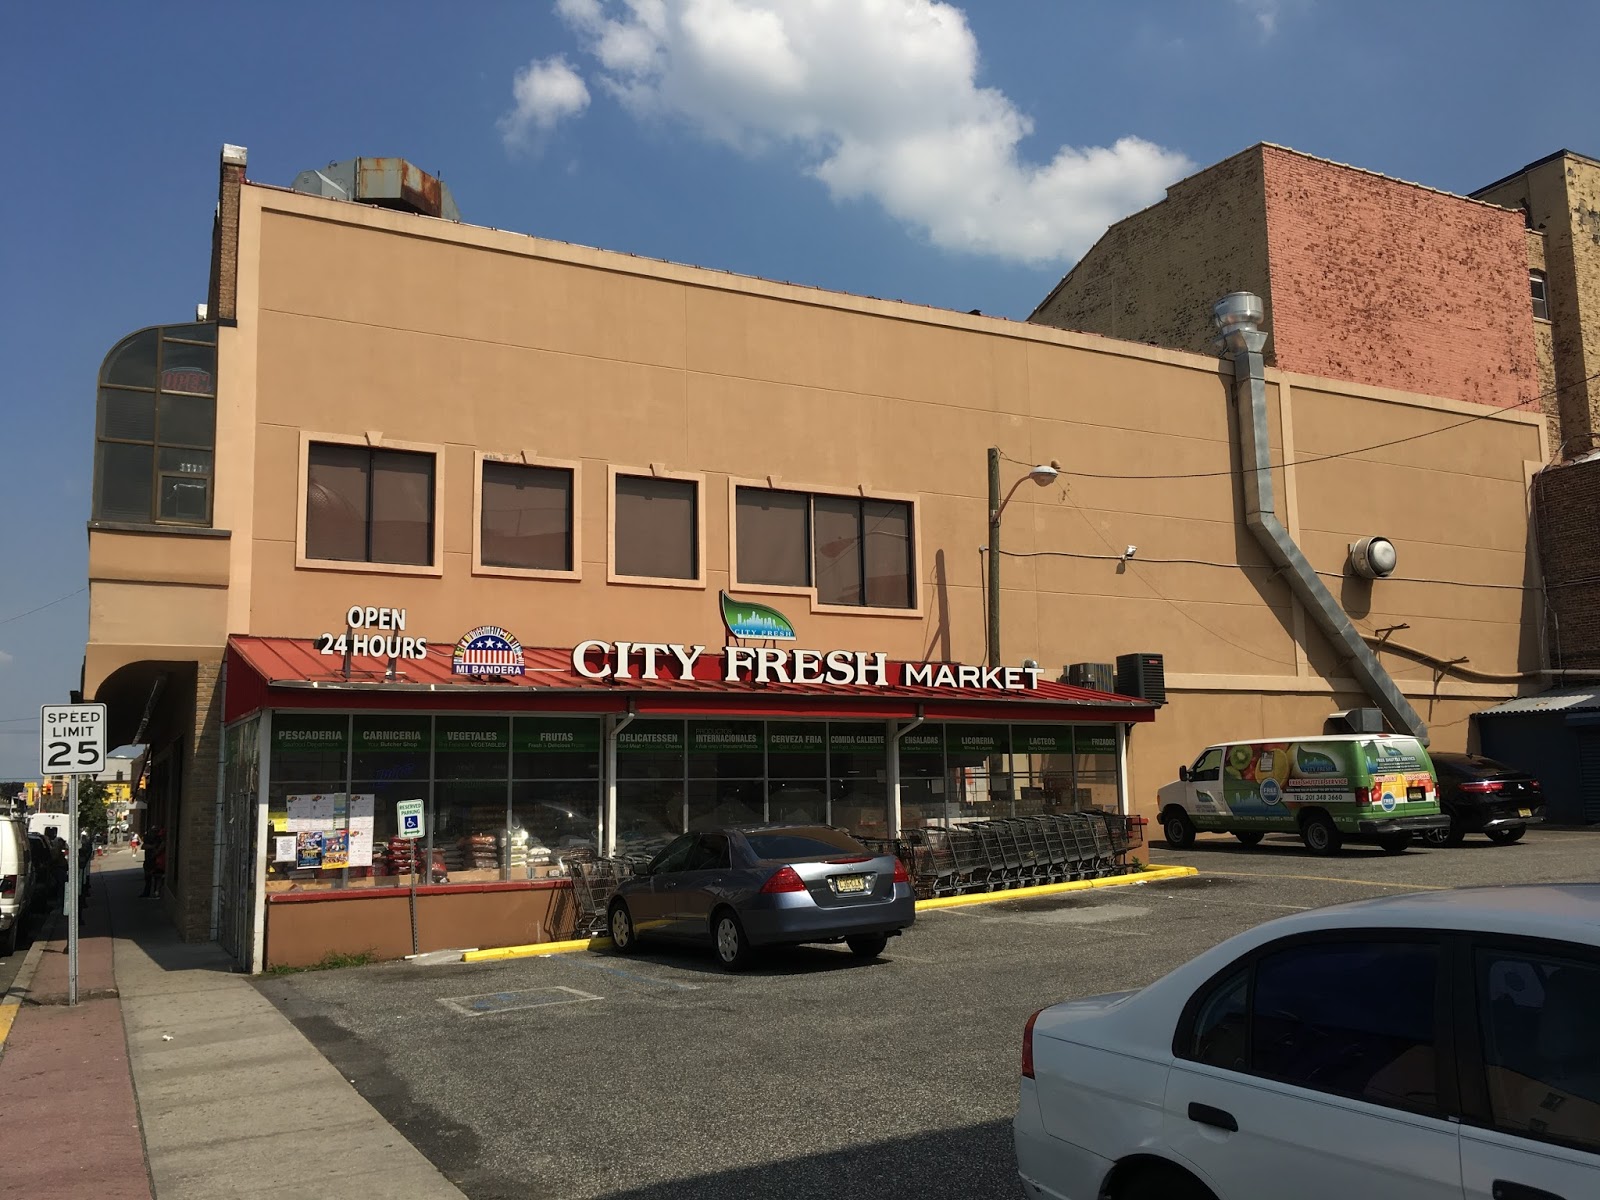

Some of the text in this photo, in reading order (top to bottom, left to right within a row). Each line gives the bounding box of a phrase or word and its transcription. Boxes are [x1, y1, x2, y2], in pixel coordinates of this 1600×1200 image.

[347, 605, 406, 631] OPEN
[320, 632, 428, 660] 24 HOURS
[456, 664, 522, 675] MI BANDERA
[572, 640, 1045, 691] CITY FRESH MARKET
[48, 712, 100, 724] SPEED
[53, 726, 94, 738] LIMIT
[278, 730, 342, 740] PESCADERIA
[363, 731, 421, 740] CARNICERIA
[447, 732, 498, 740] VEGETALES
[540, 732, 574, 741] FRUTAS
[620, 734, 678, 742] DELICATESSEN
[696, 735, 756, 743] INTERNACIONALES
[771, 735, 822, 744] CERVEZA FRIA
[48, 741, 100, 766] 25
